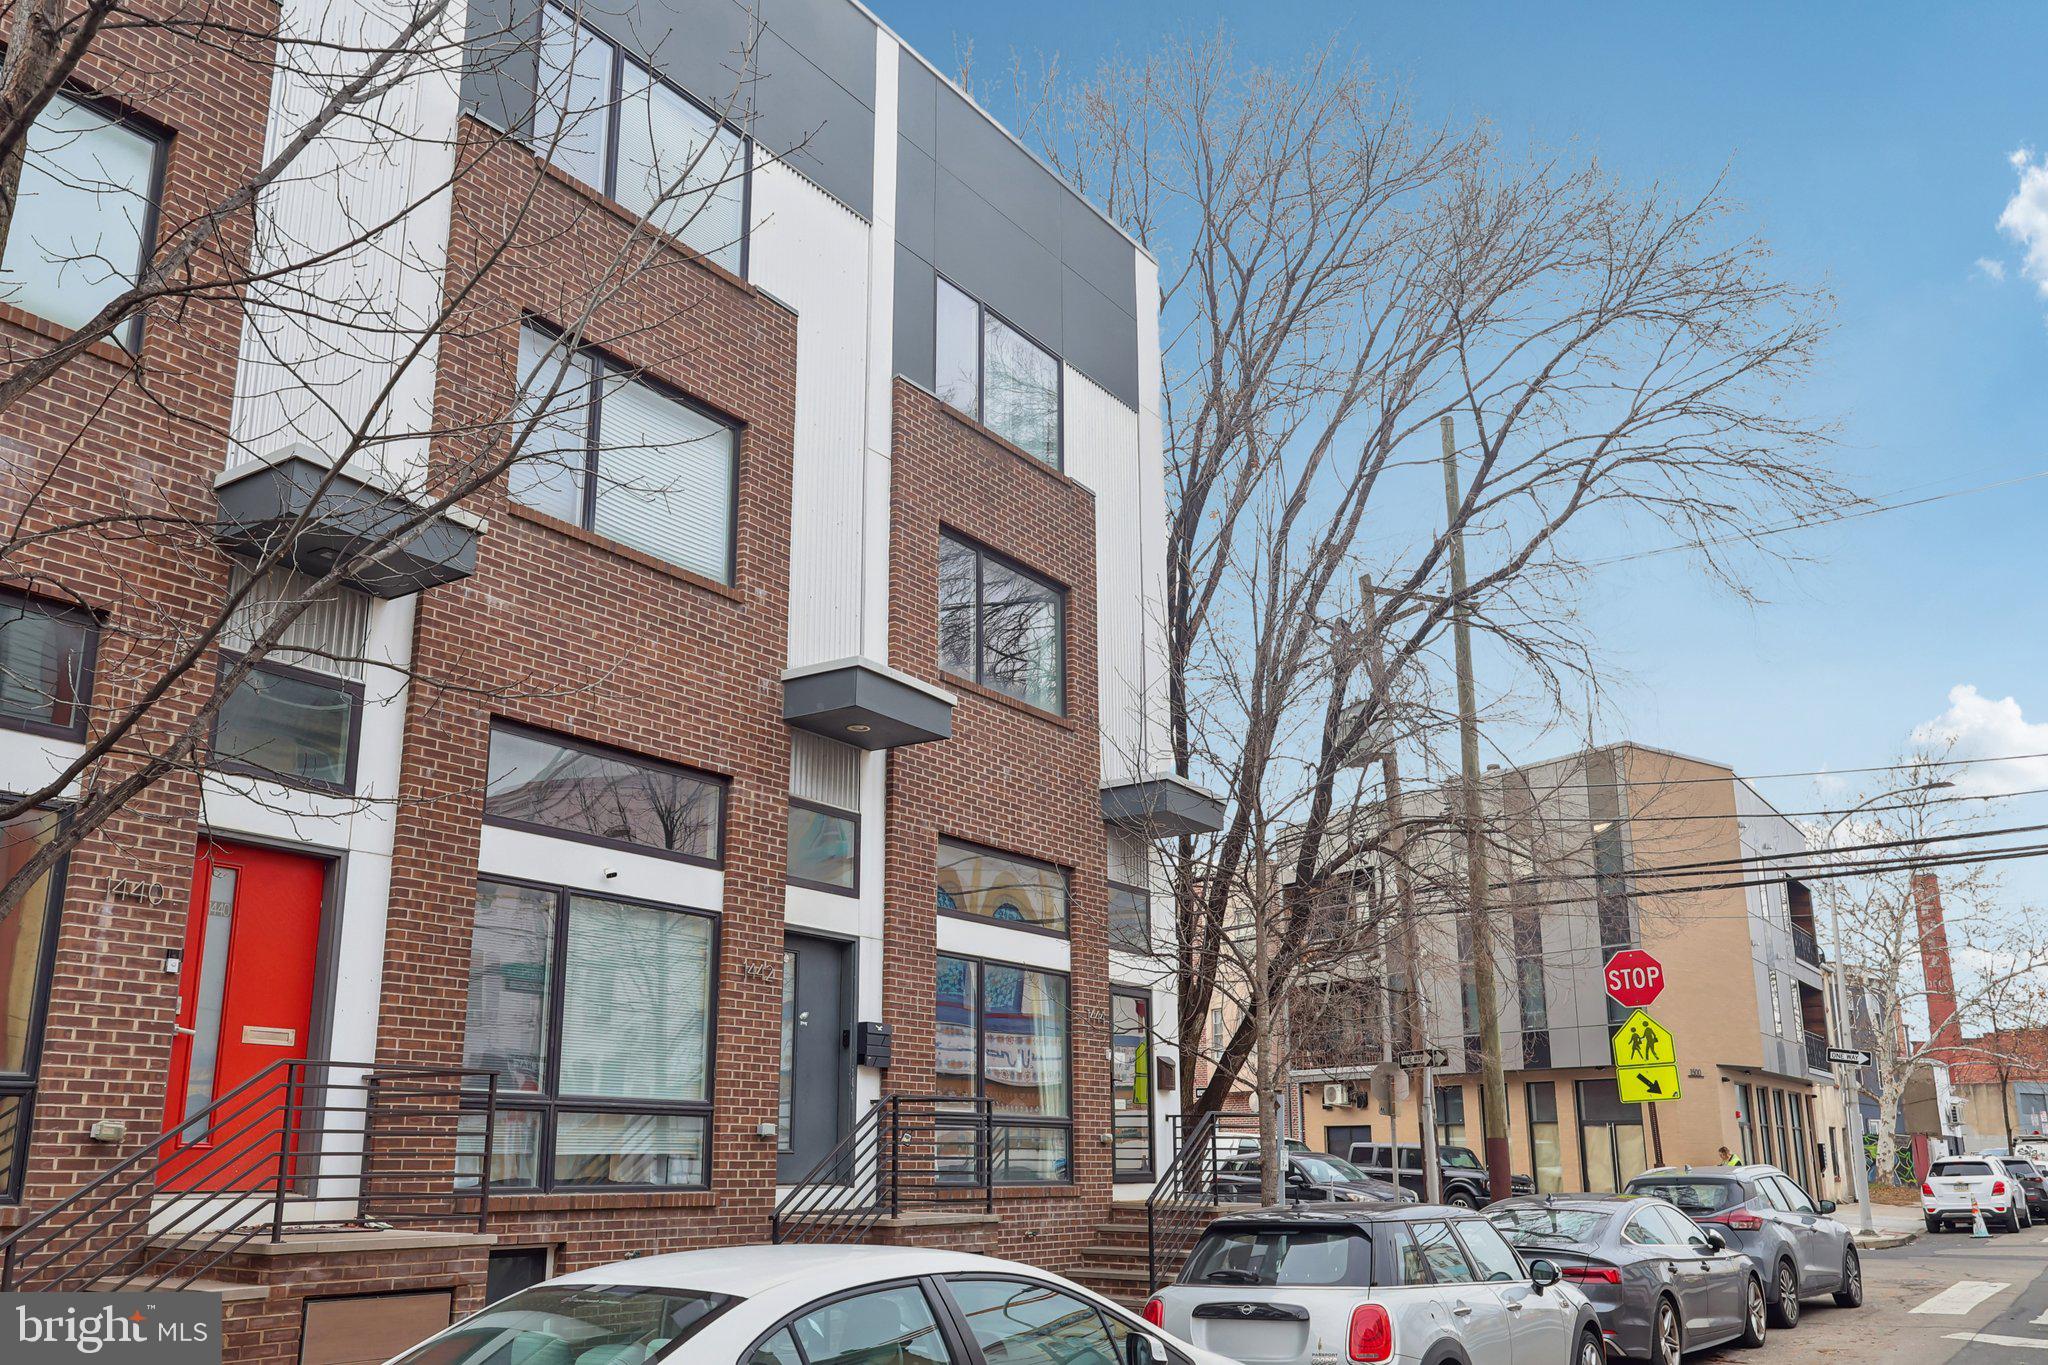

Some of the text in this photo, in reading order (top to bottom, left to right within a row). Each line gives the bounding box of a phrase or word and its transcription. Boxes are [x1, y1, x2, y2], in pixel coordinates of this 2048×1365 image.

[105, 876, 165, 905] 1440
[744, 957, 775, 983] 1442
[1608, 966, 1660, 991] STOP
[1831, 1052, 1845, 1060] ONE
